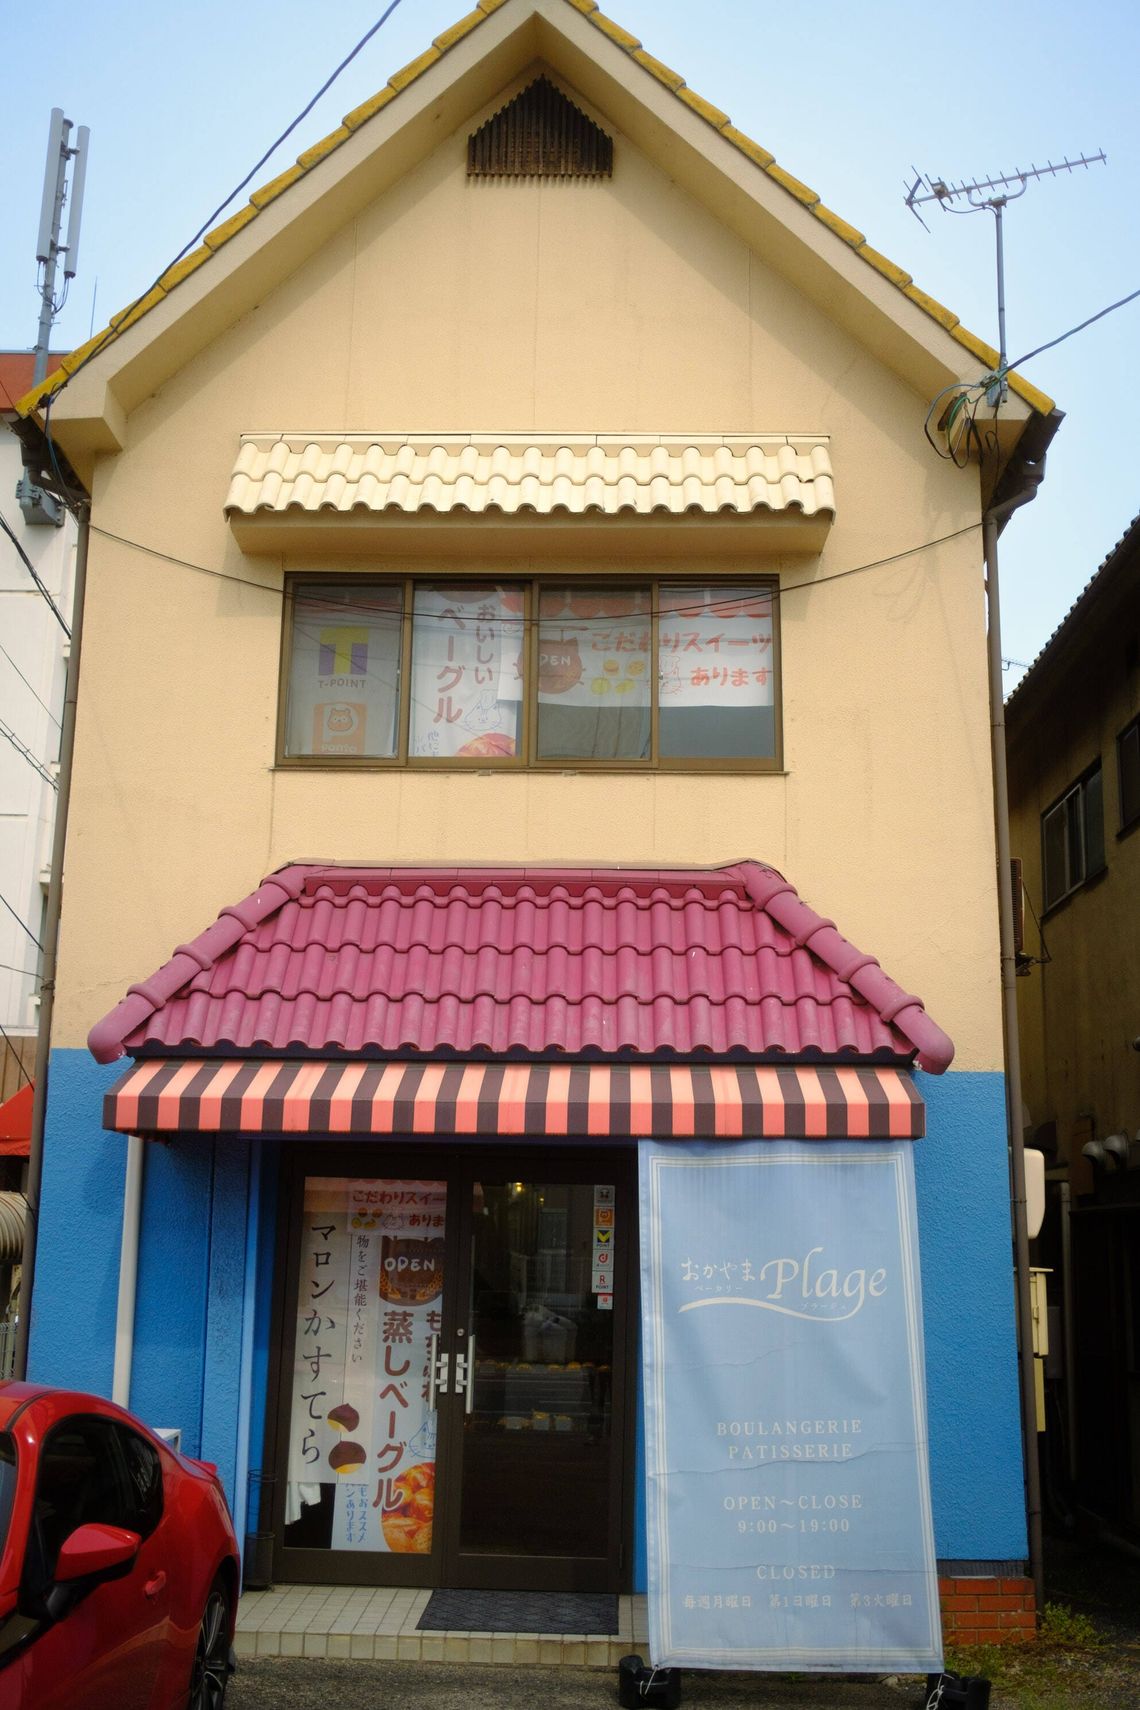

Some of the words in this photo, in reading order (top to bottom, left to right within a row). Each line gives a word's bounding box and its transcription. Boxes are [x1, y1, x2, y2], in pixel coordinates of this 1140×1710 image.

[475, 604, 496, 685] おいしい
[432, 605, 466, 724] ベーグル
[539, 654, 571, 666] PEN
[317, 678, 368, 689] T-POINT
[690, 667, 772, 687] あります
[352, 1190, 446, 1205] こだわりスイー
[408, 1214, 445, 1228] ありま
[384, 1255, 435, 1272] OPEN
[680, 1257, 756, 1281] おかやま
[759, 1247, 888, 1306] Plage
[351, 1235, 370, 1362] 物をご堪能ください
[301, 1224, 336, 1464] マロンかすてら
[372, 1310, 415, 1508] 蒸しベーグル
[716, 1419, 863, 1436] BOULANGERIE
[728, 1443, 853, 1460] PATISSERIE
[756, 1564, 836, 1580] CLOSED
[682, 1593, 752, 1609] 毎週月曜日
